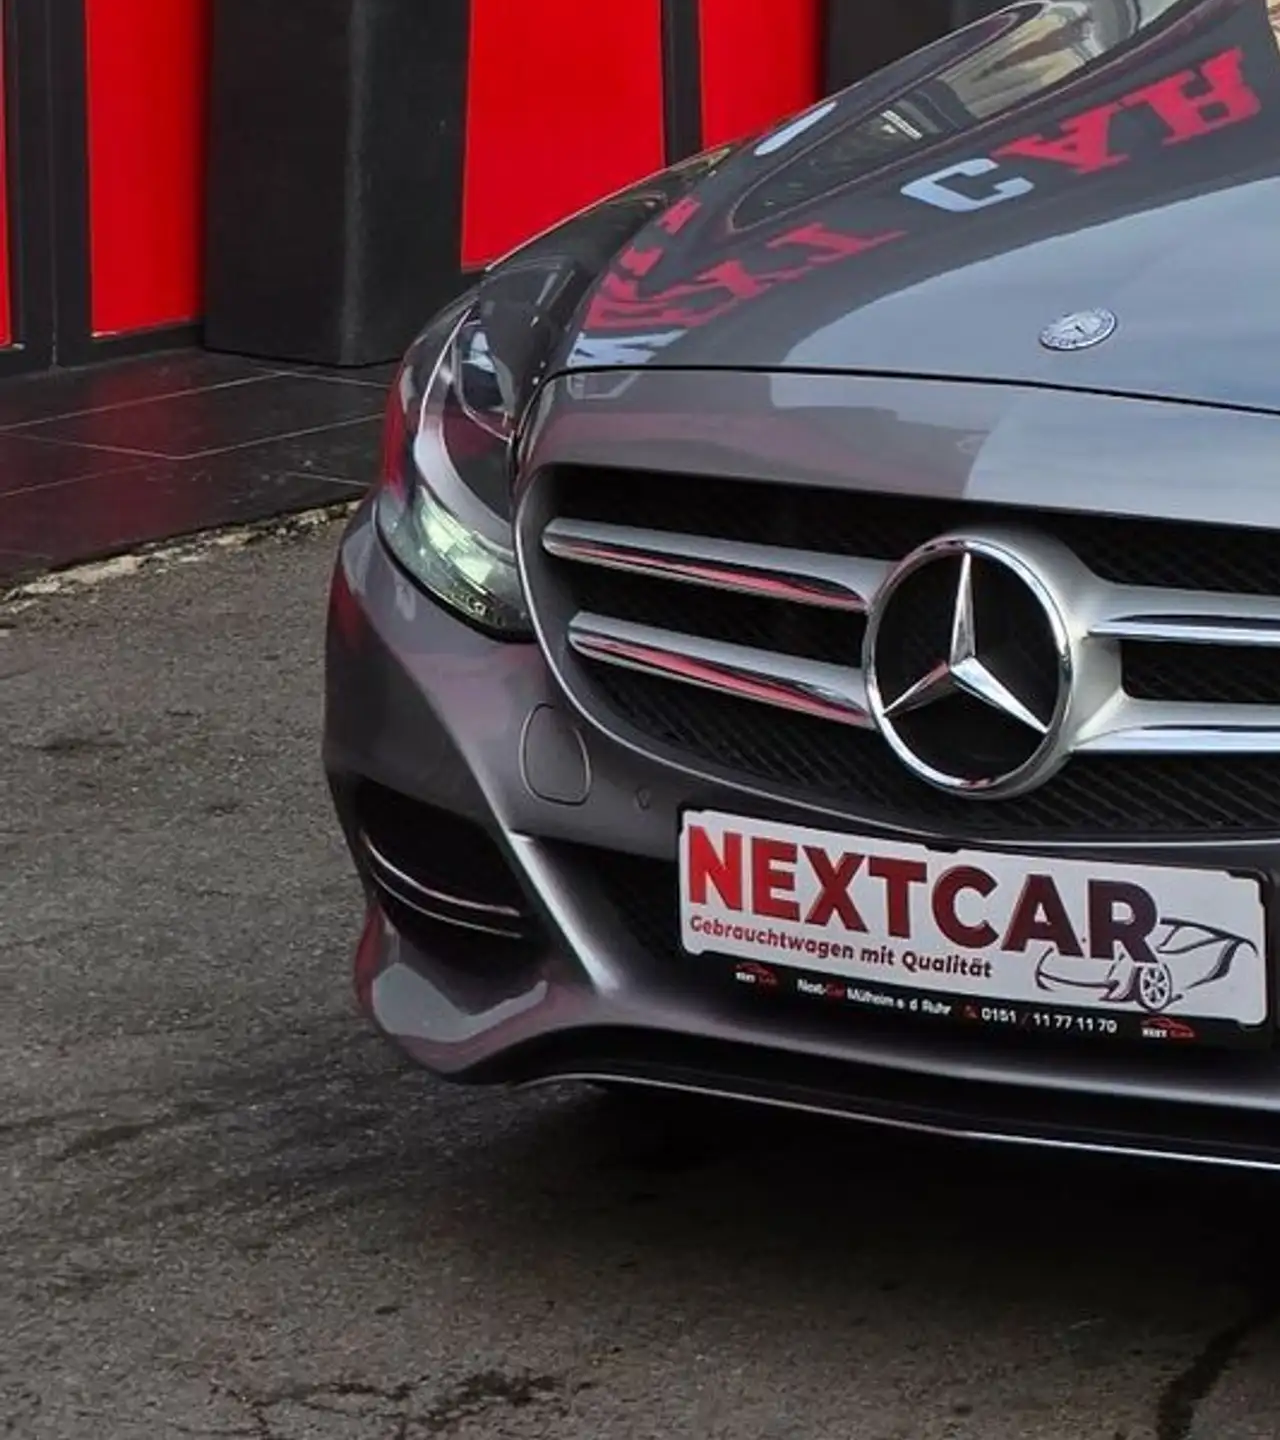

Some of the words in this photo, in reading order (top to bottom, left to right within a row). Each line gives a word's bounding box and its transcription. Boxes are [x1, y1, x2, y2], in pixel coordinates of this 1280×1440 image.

[688, 824, 1159, 964] NEXTCAR
[690, 915, 854, 959] Gebrauchtwagen
[860, 945, 896, 966] mit
[902, 949, 993, 979] Qualität
